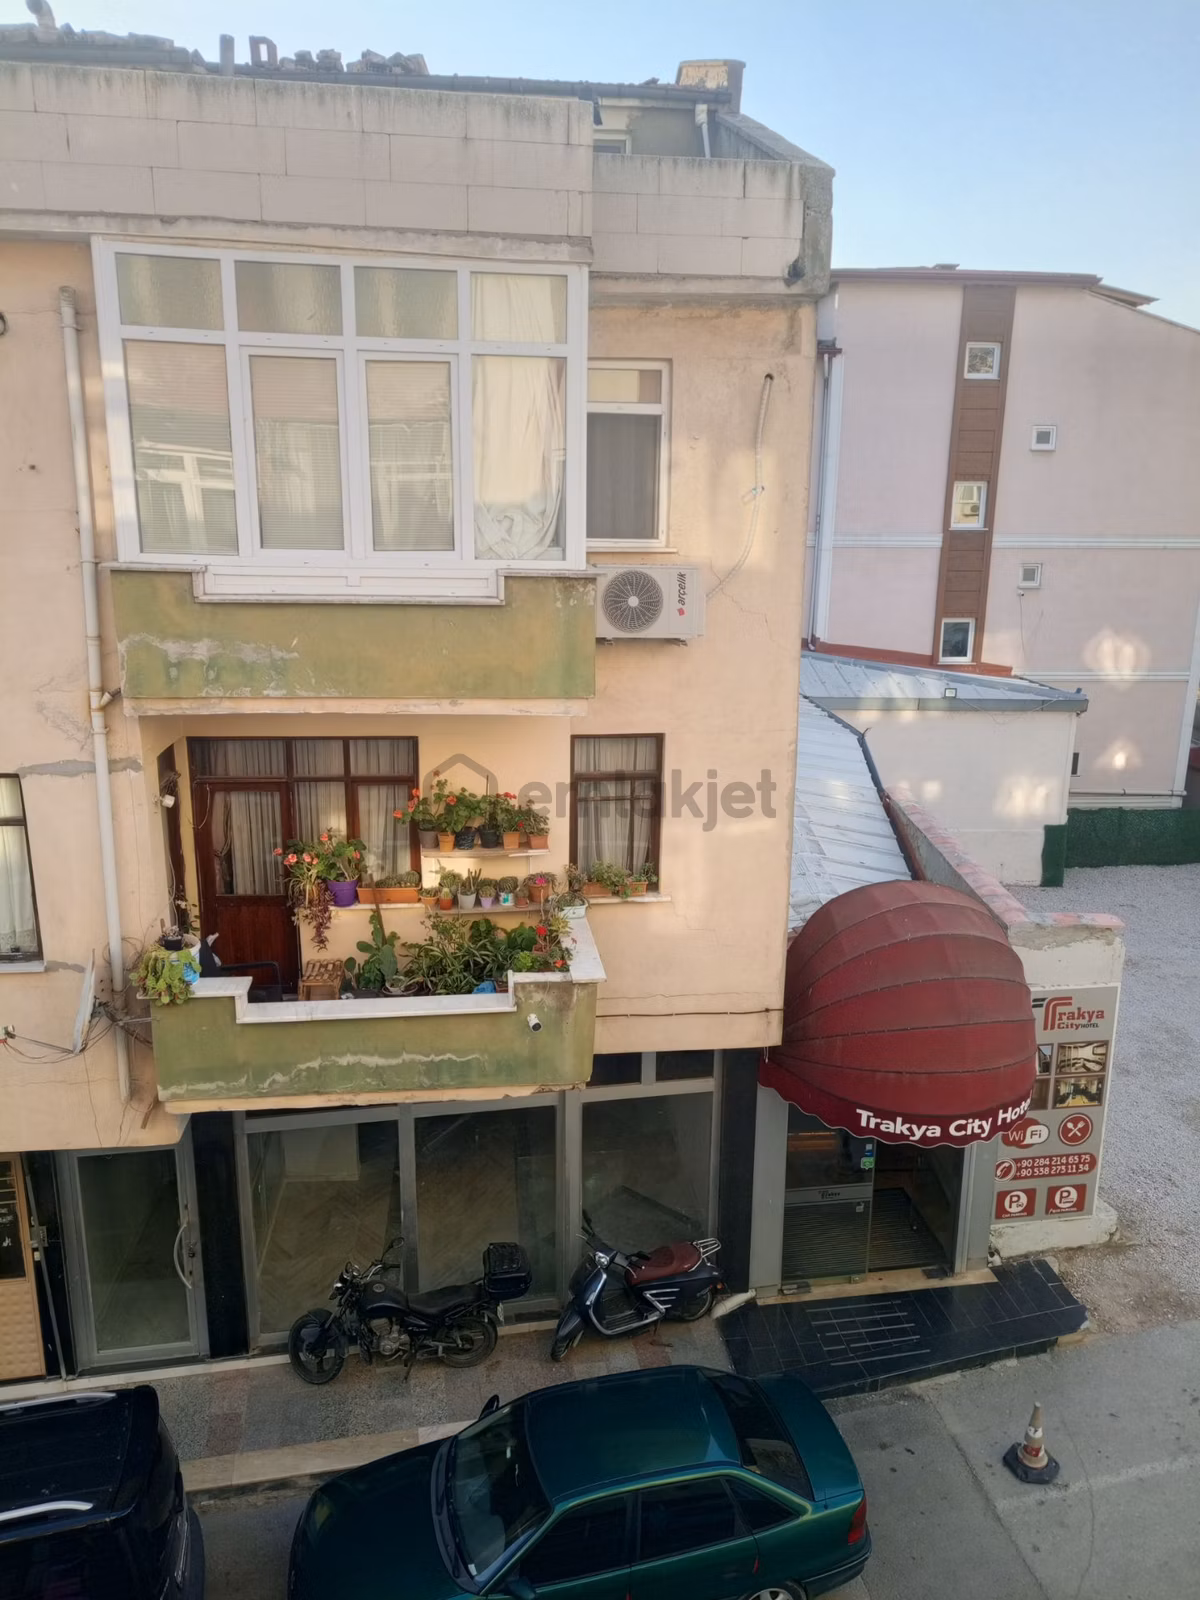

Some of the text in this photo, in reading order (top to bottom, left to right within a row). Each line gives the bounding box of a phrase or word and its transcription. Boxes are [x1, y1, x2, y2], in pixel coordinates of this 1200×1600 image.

[677, 571, 688, 606] arçelik
[855, 1096, 1032, 1141] Trakya City Hote
[1015, 1168, 1032, 1177] +90
[1067, 1164, 1076, 1173] 11
[1016, 1153, 1091, 1168] +90 284 214 65 75
